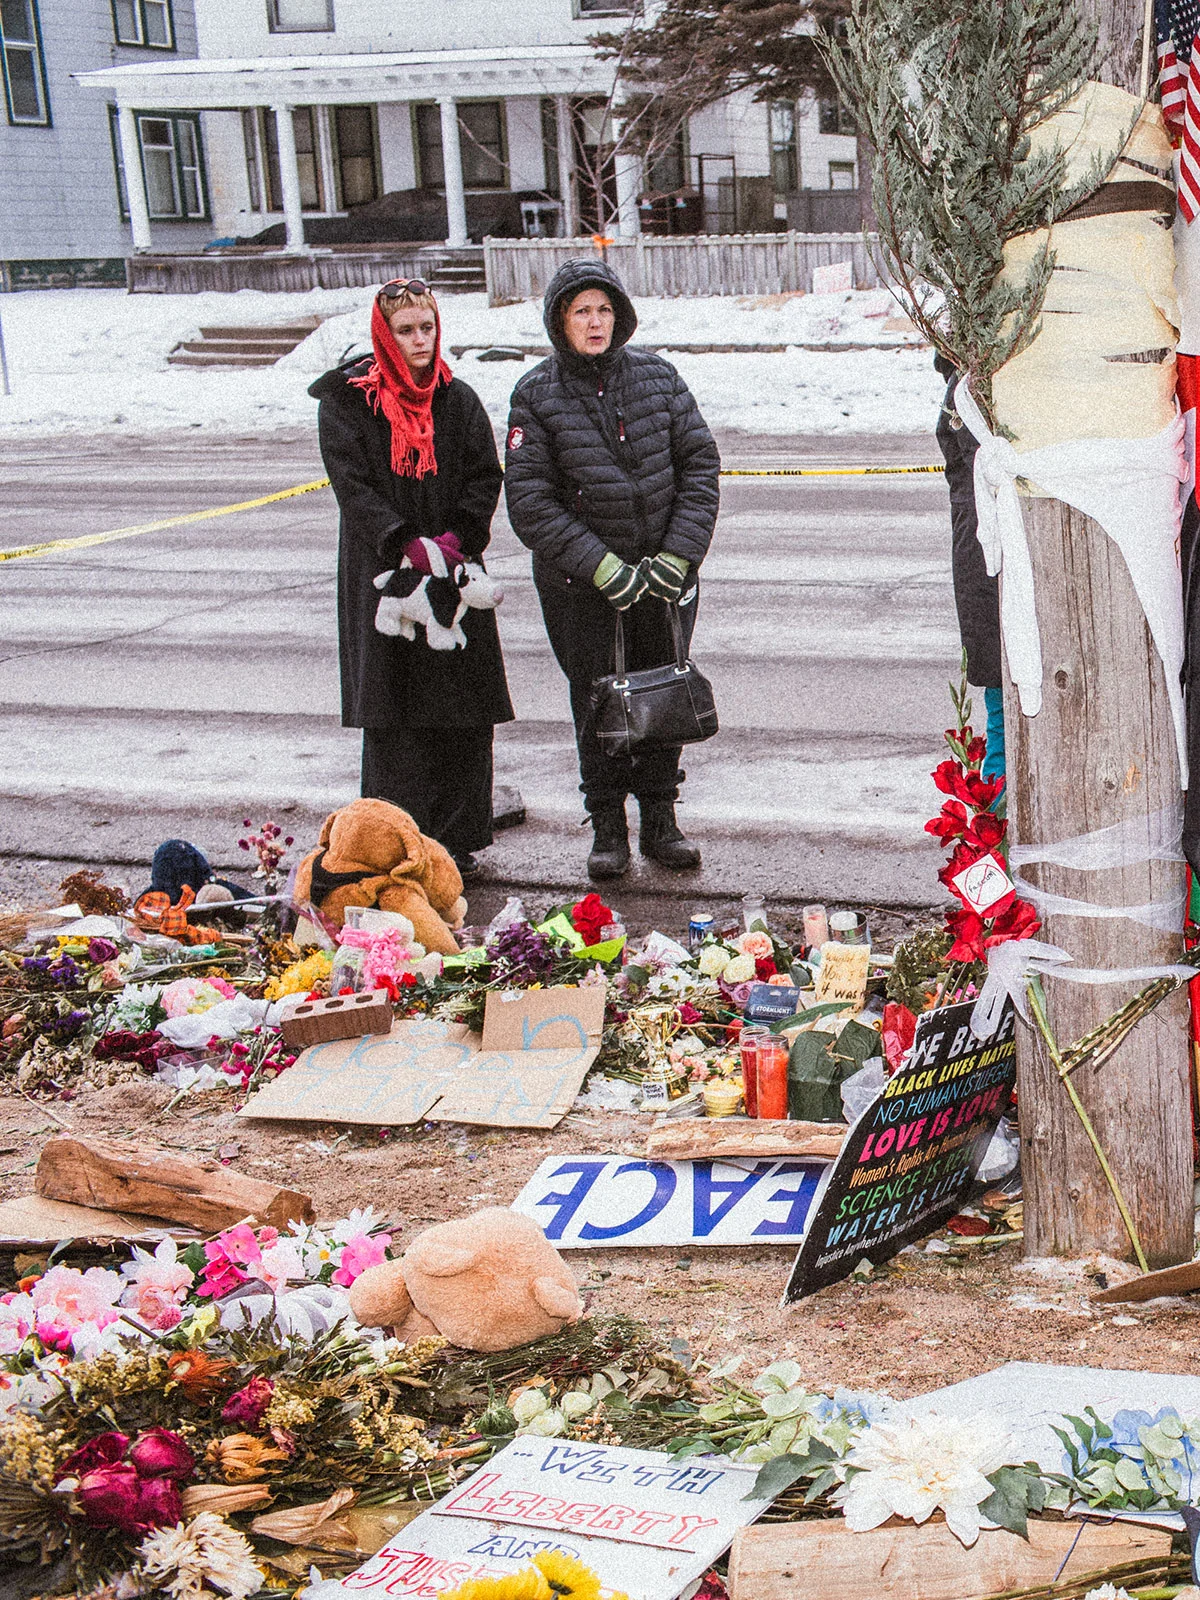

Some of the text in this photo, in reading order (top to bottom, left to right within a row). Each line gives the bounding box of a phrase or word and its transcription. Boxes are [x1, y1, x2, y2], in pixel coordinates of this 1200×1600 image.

[948, 1010, 1016, 1060] BEE
[885, 1040, 1016, 1099] BLACK LIVES MATTE
[859, 1084, 1005, 1163] LOVE IS LOVE
[872, 1099, 905, 1127] NO
[905, 1082, 961, 1118] HUMAN
[535, 1161, 829, 1240] EACE
[836, 1169, 922, 1221] SCIENCE
[922, 1159, 941, 1186] IS
[849, 1157, 896, 1189] Women's
[826, 1203, 901, 1248] WATER
[907, 1189, 928, 1215] IS
[930, 1166, 970, 1201] LIFE
[446, 1473, 720, 1545] LIBERTY
